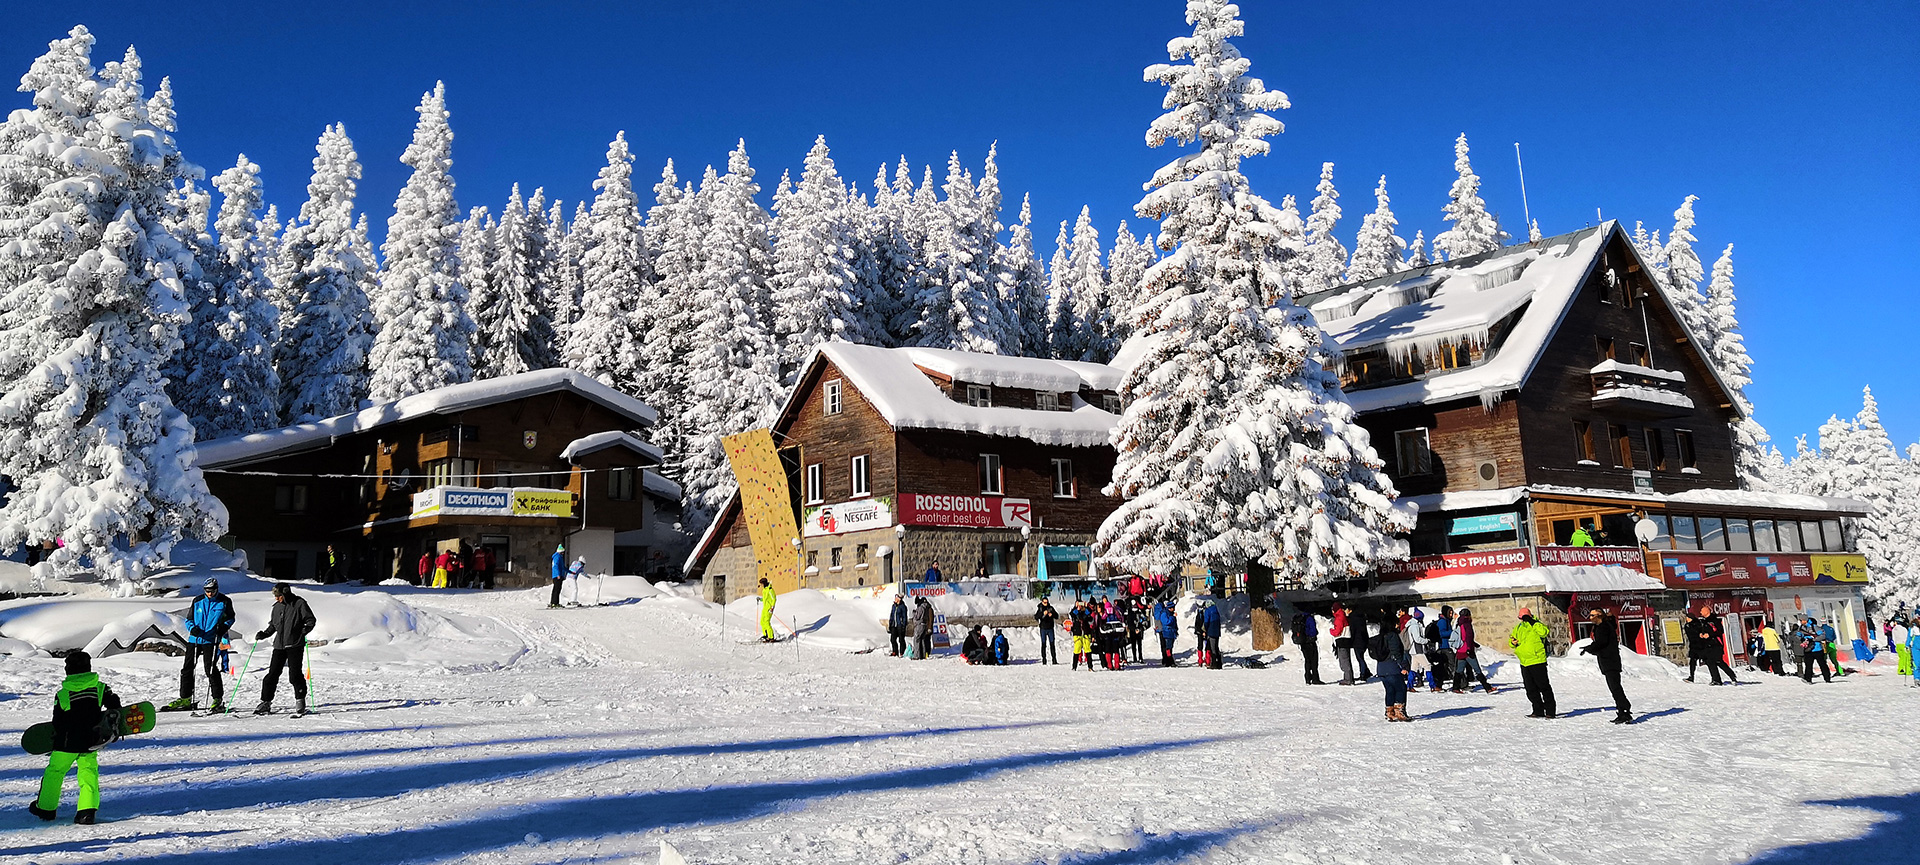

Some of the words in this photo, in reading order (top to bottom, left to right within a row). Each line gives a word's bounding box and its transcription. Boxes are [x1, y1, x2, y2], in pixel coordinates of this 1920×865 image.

[447, 494, 505, 506] DECATHLON
[915, 493, 990, 513] ROSSIGNOL
[916, 513, 951, 523] another
[953, 513, 972, 524] best
[975, 515, 991, 526] day
[1468, 557, 1487, 567] ТРИ
[1488, 555, 1496, 565] В
[1497, 552, 1525, 565] ЕДНО
[910, 588, 946, 597] OUTDOOR
